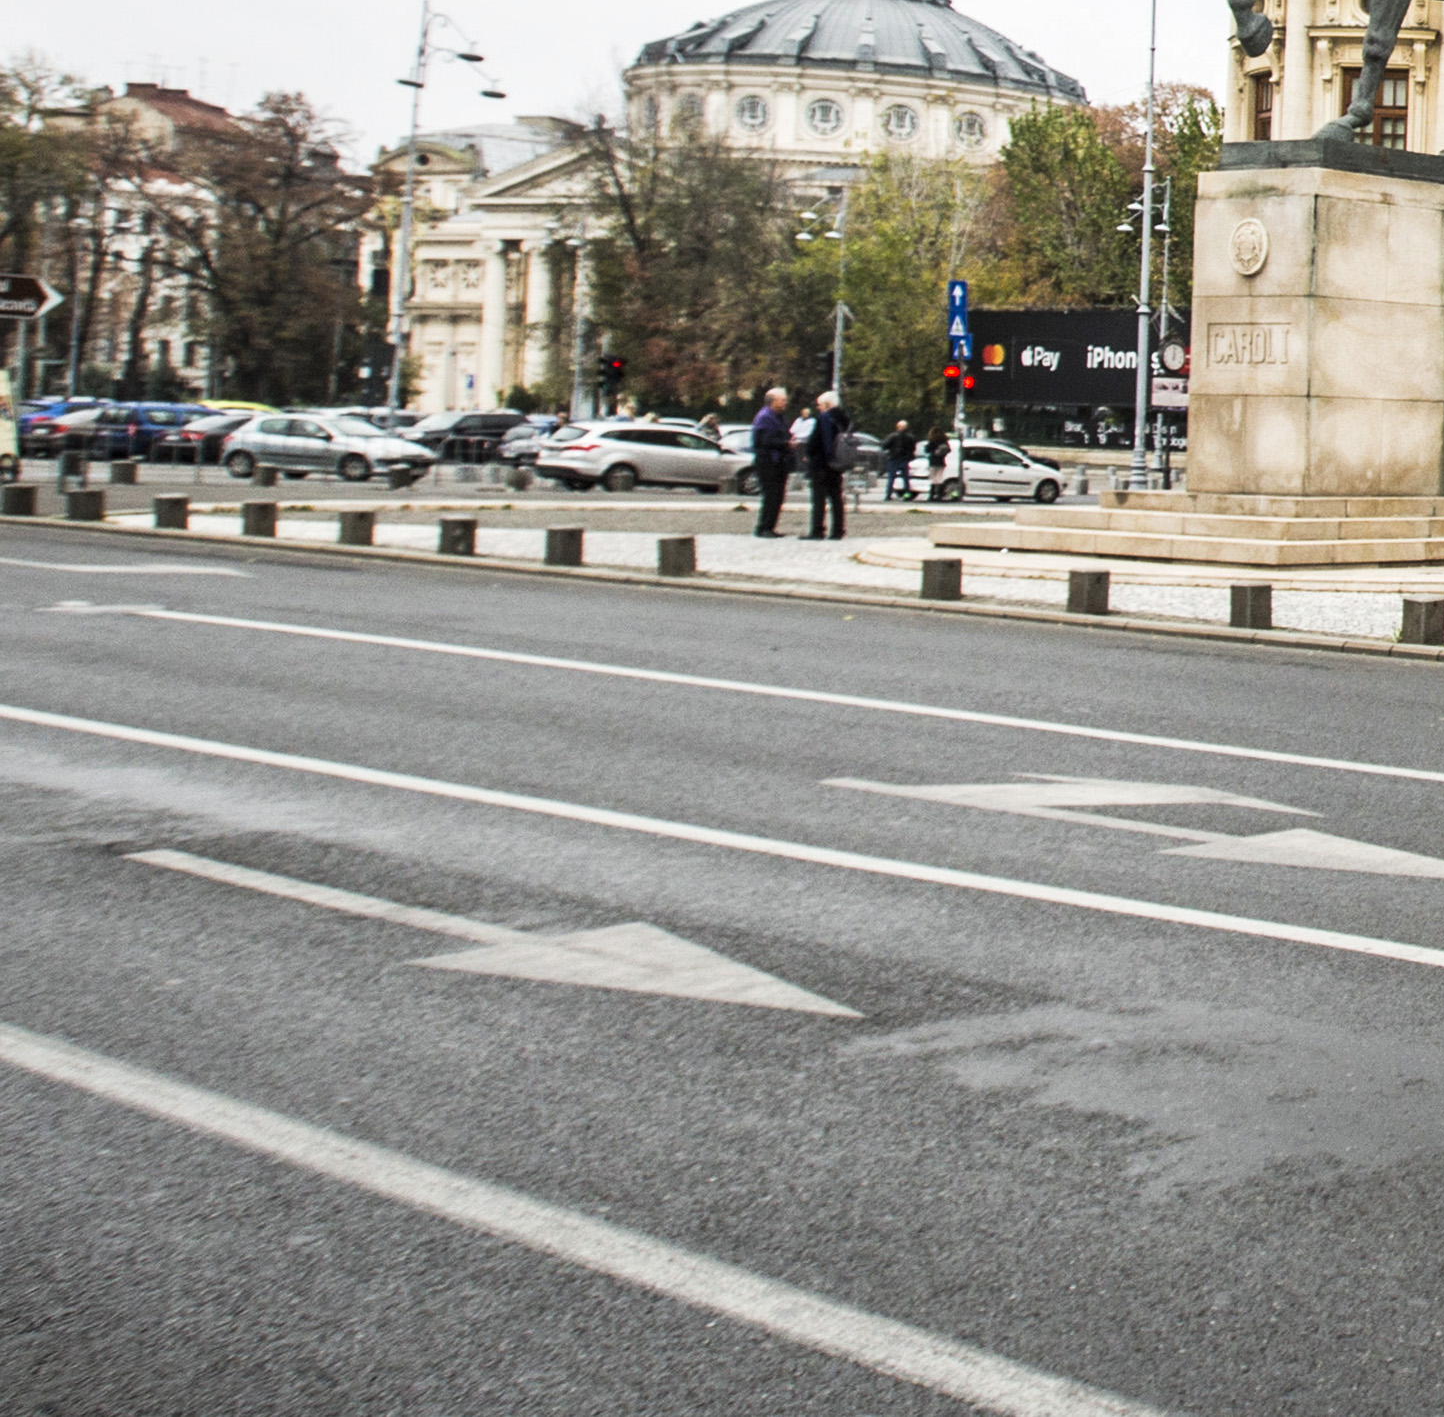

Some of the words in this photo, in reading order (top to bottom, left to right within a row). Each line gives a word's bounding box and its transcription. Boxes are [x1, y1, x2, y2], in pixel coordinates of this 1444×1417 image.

[1033, 346, 1061, 372] Pay
[1086, 344, 1139, 369] iPhon
[1212, 328, 1276, 365] CAROL
